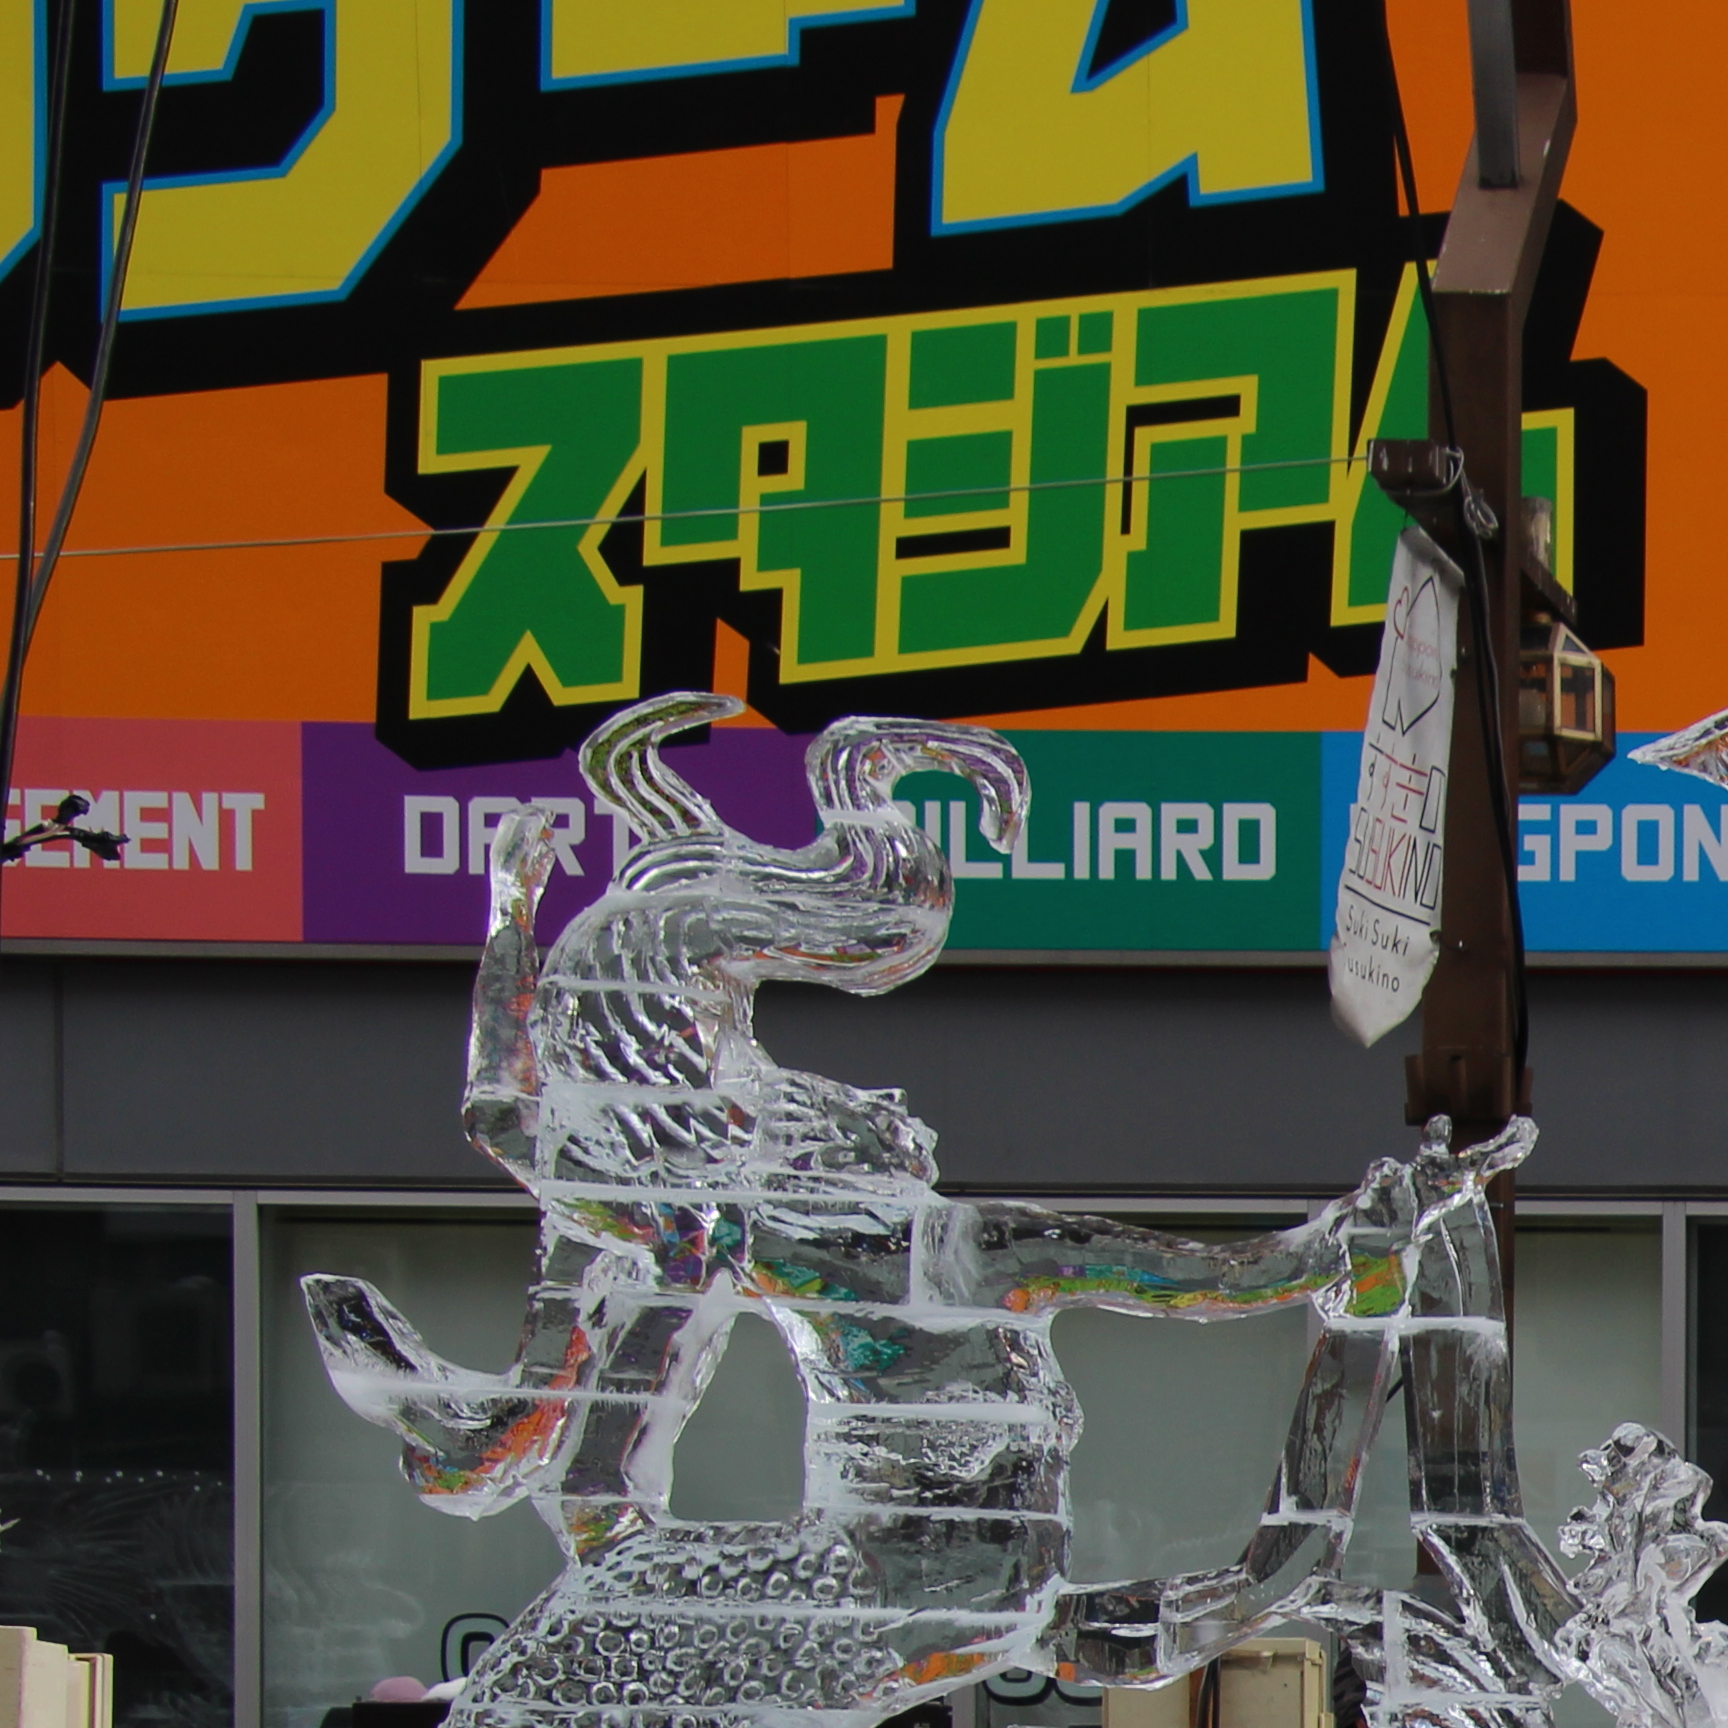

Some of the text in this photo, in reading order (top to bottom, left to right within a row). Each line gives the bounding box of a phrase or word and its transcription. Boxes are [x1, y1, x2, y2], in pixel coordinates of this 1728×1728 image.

[925, 799, 1277, 883] ILLIARD
[1349, 806, 1444, 908] SUSUKINO
[1345, 908, 1412, 958] Suki Suki
[1345, 954, 1402, 993] usukino
